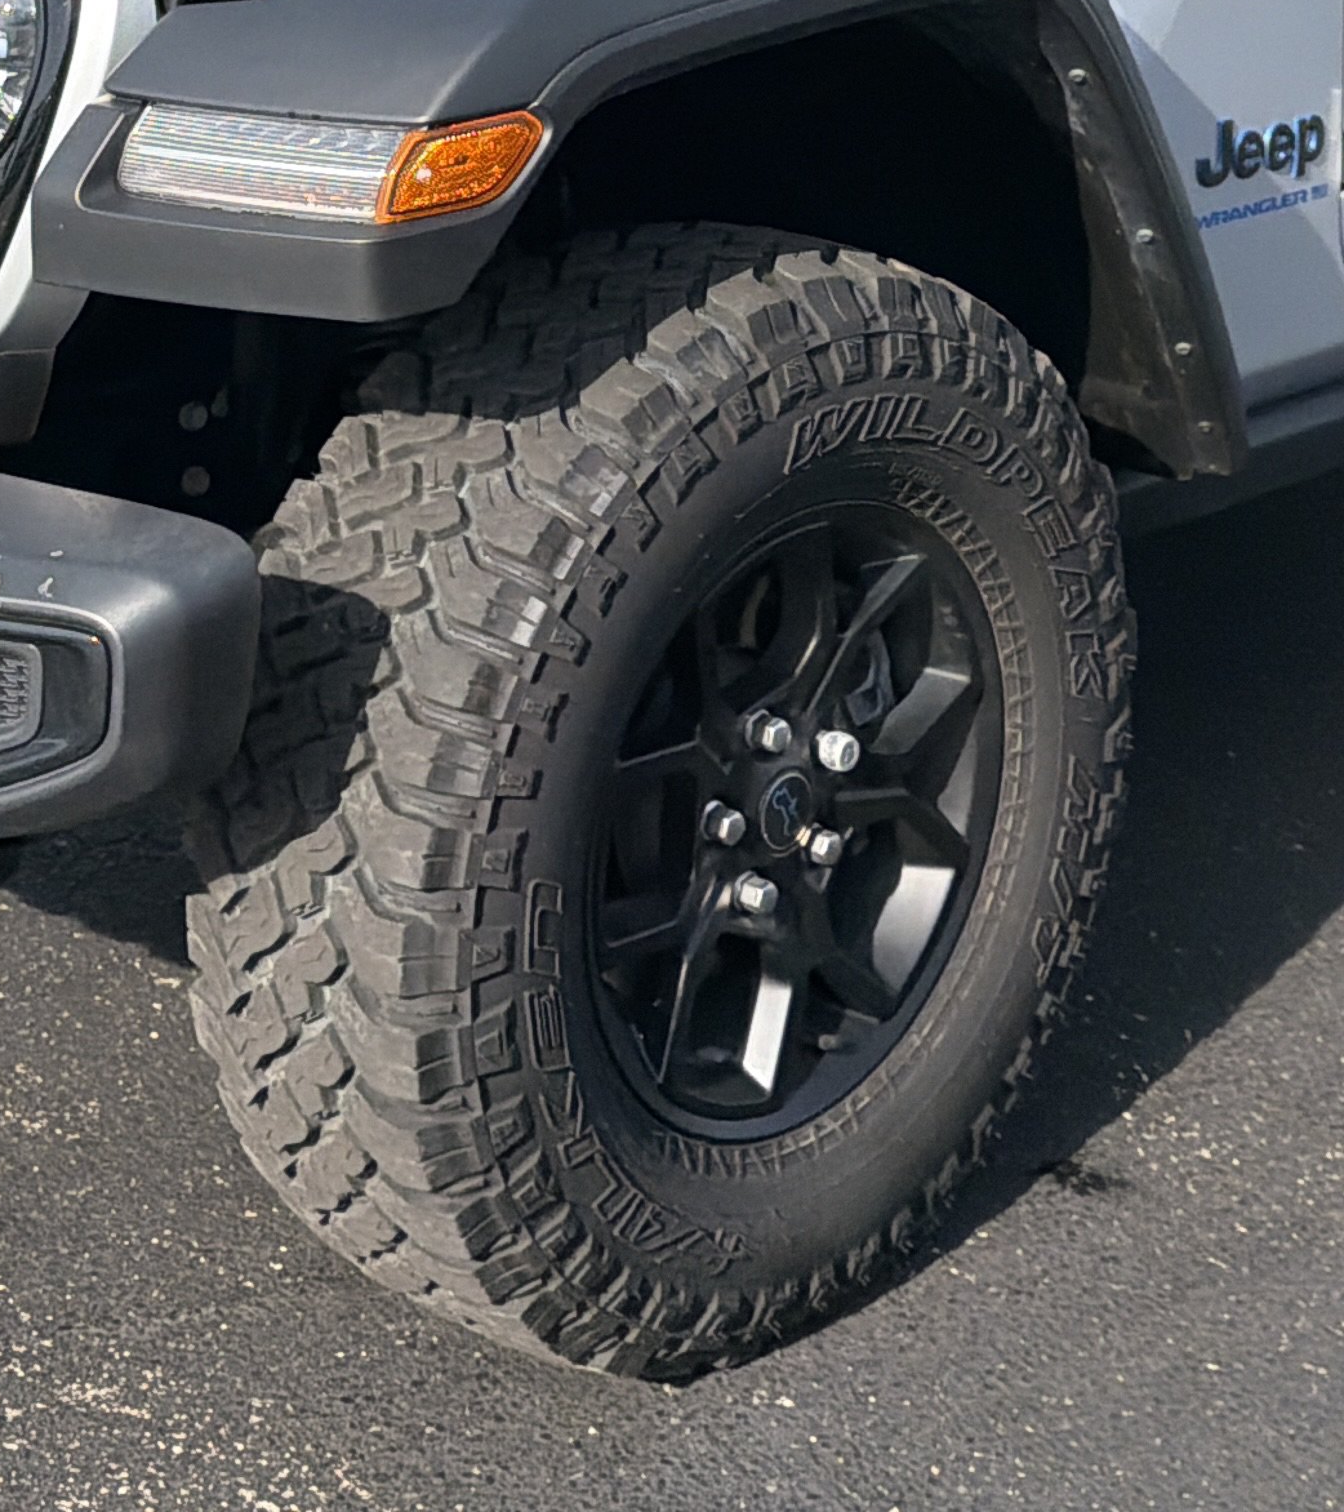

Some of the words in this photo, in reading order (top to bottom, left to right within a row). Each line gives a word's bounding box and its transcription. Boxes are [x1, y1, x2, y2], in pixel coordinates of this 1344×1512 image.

[1195, 113, 1325, 188] Jeep
[1196, 189, 1309, 229] WRANGLER
[783, 392, 1104, 699] WILDPEAK
